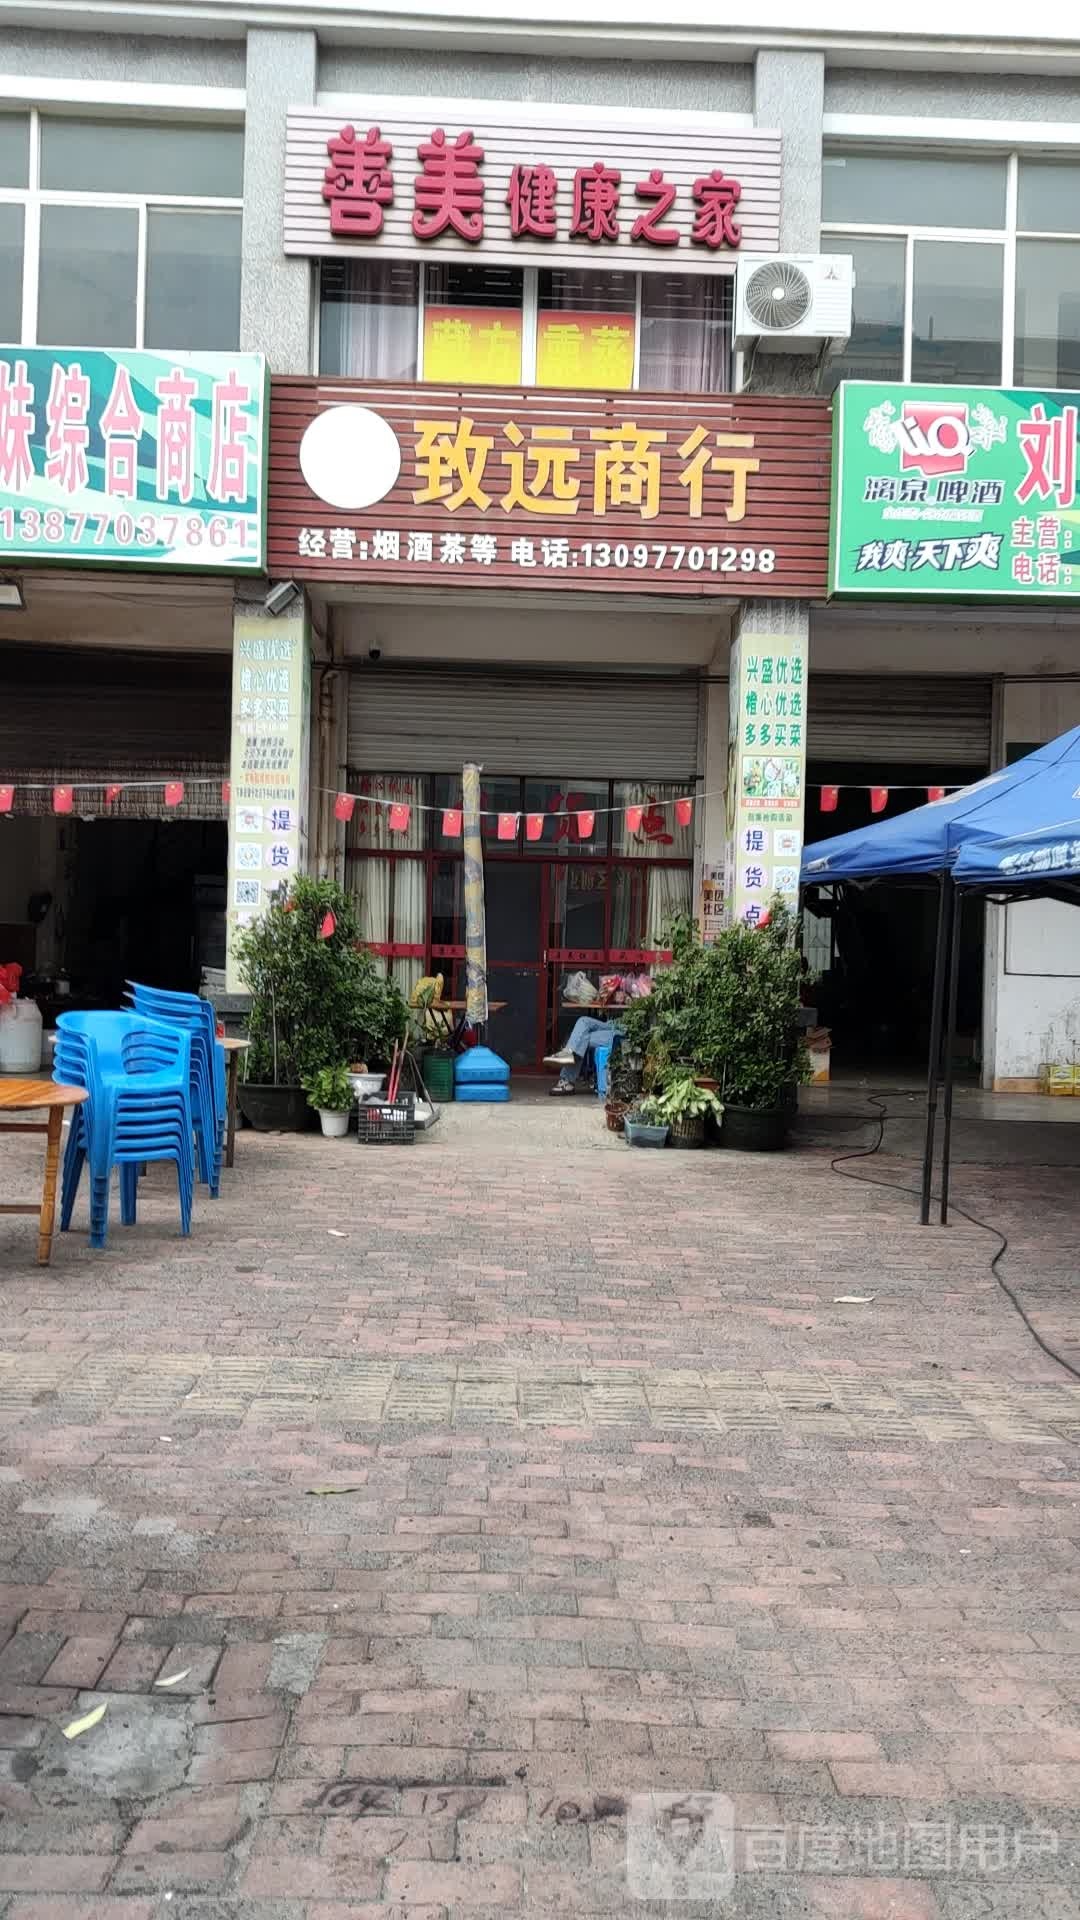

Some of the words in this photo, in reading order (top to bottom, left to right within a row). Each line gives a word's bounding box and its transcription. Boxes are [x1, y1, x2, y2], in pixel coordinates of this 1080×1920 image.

[322, 125, 743, 249] 善美健康之家
[0, 361, 252, 501] 妹综合商店
[1016, 405, 1076, 506] 刘
[410, 416, 761, 523] 致远商行
[864, 477, 1003, 504] 漓泉啤酒
[0, 509, 249, 548] 13877037861
[745, 654, 804, 686] 兴盛优选
[743, 721, 803, 748] 多多买菜
